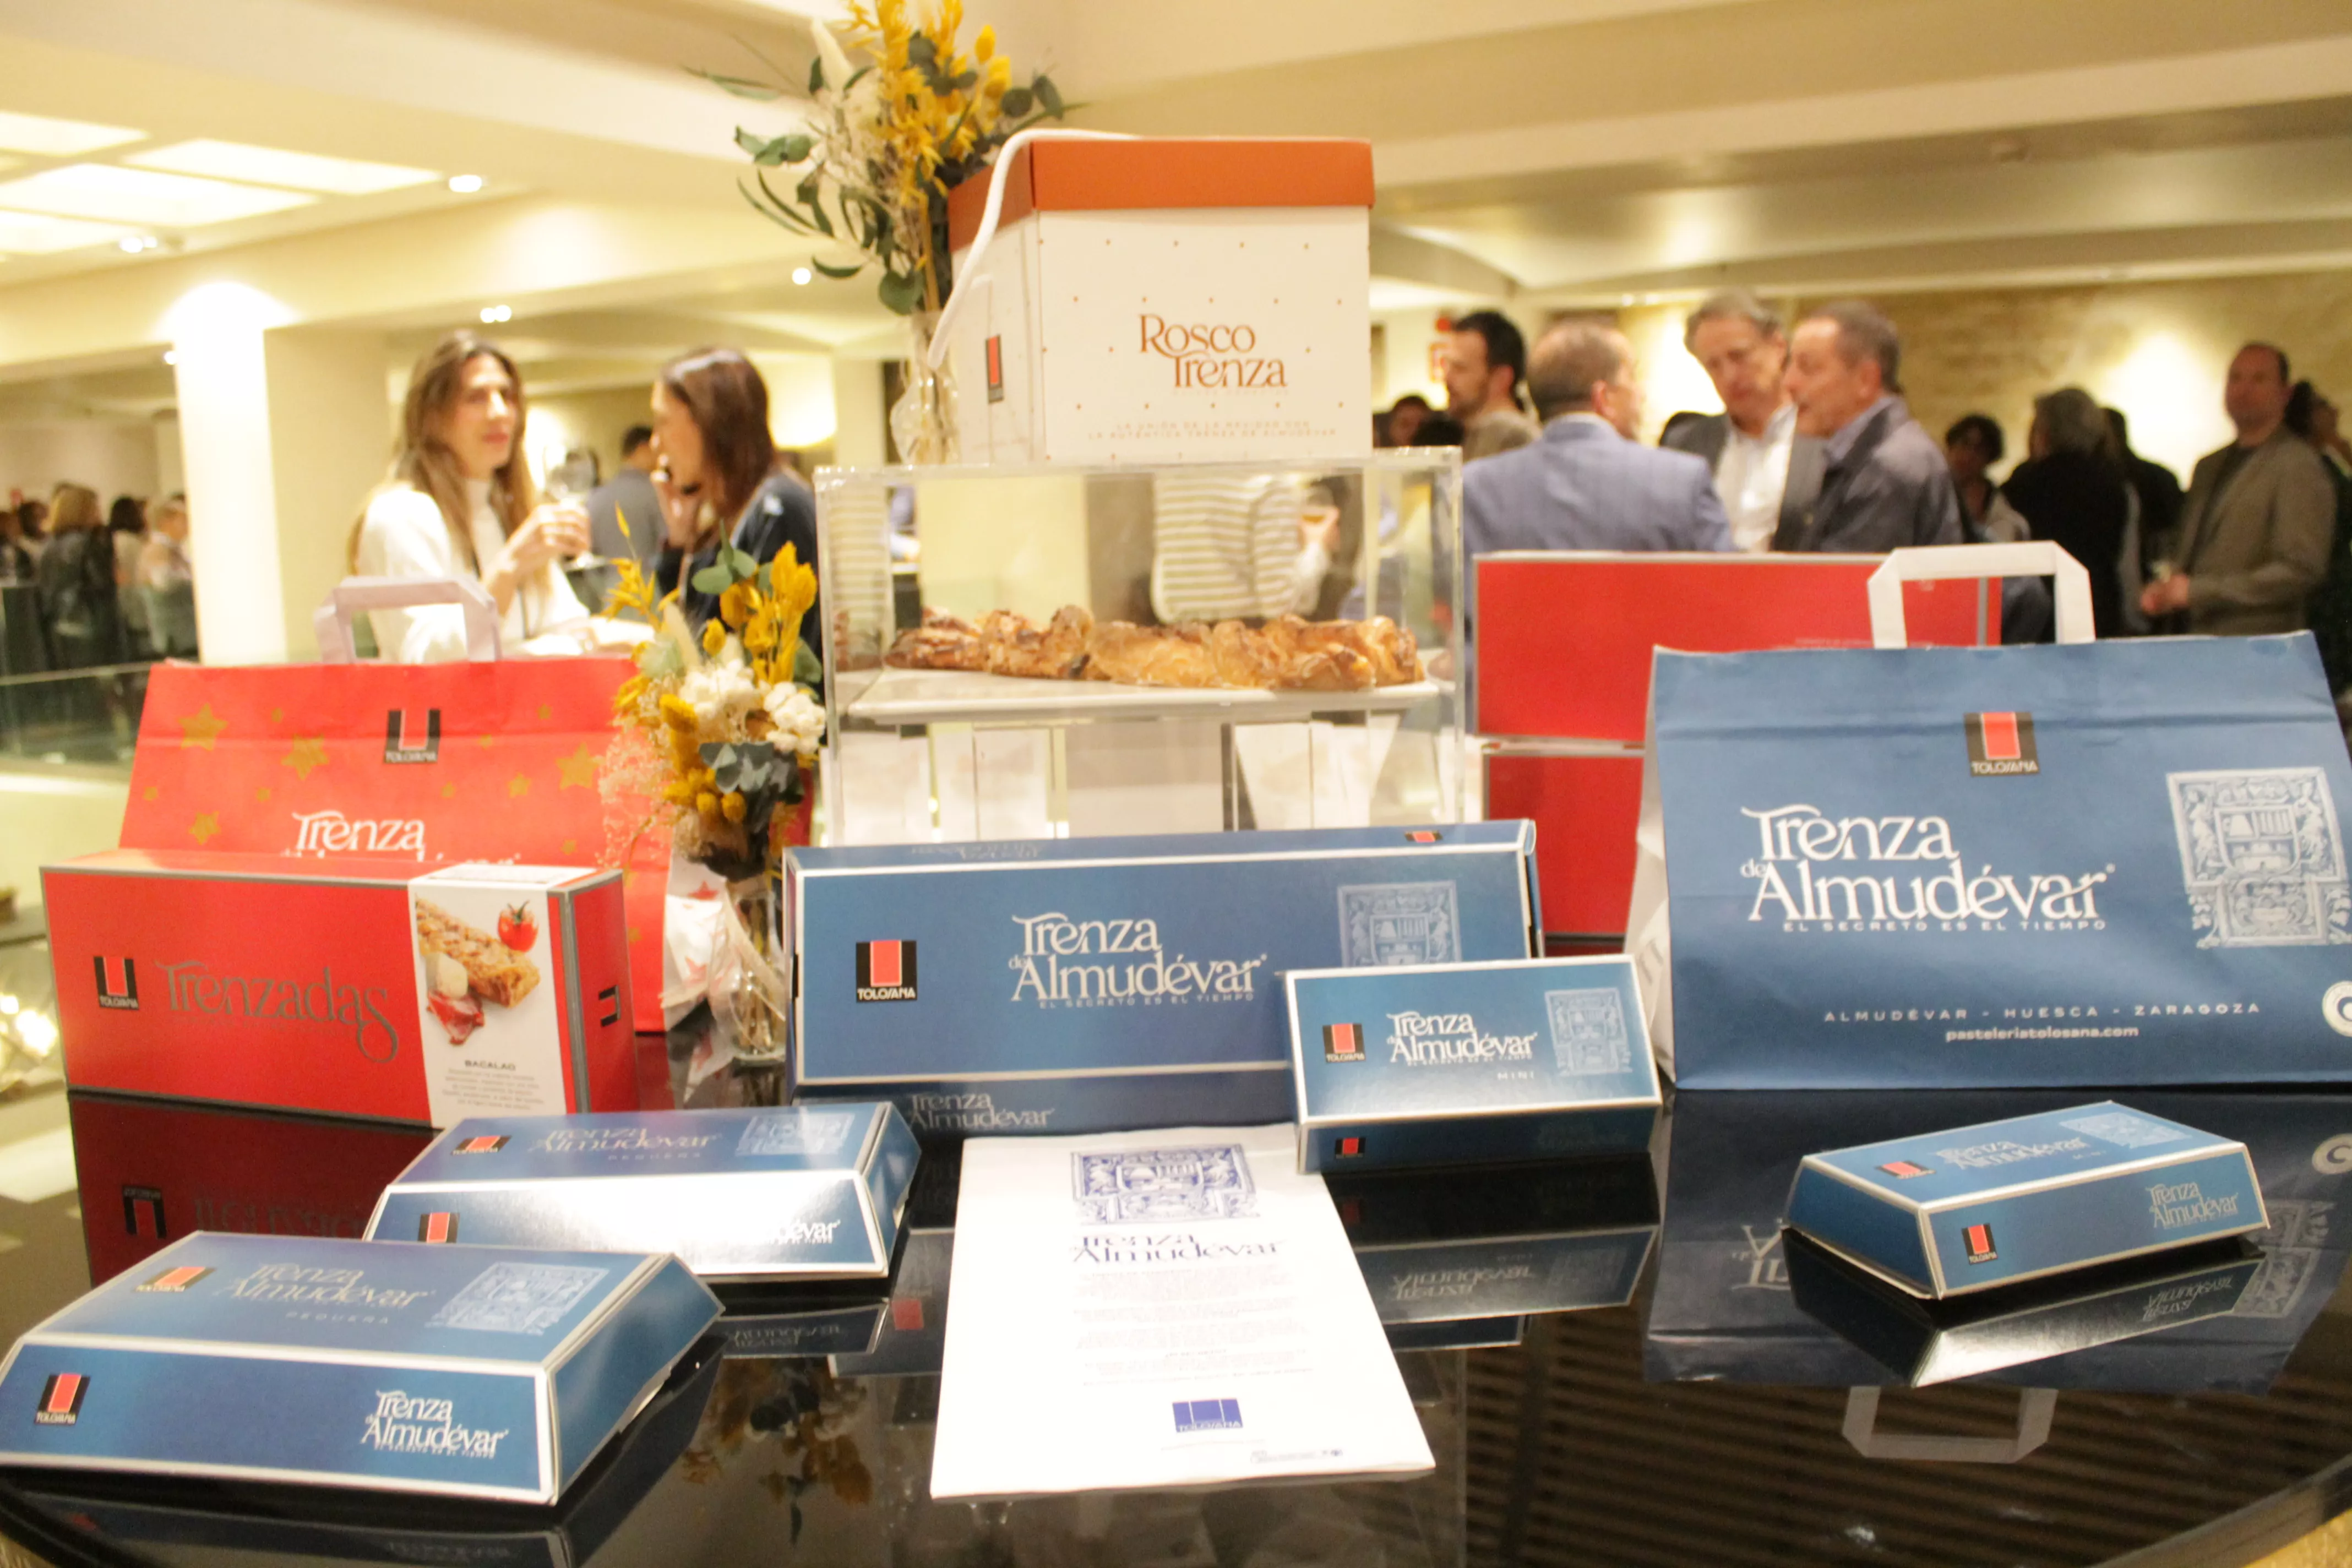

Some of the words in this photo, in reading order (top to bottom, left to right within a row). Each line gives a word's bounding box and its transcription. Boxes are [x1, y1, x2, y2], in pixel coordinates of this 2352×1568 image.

[1138, 314, 1256, 359] Rosco
[1173, 352, 1288, 389] Trenza
[292, 810, 426, 851] Trenza
[1740, 804, 1959, 861] Trenza
[1740, 860, 1767, 878] de
[1011, 912, 1162, 956] Trenza
[1783, 922, 1809, 932] EL
[1823, 921, 1928, 932] SECRETO
[1941, 921, 1968, 931] ES
[1982, 921, 2007, 931] EL
[2020, 920, 2106, 931] TIEMPO
[1009, 955, 1027, 970] de
[1196, 993, 1254, 1003] TIEMPO
[154, 960, 399, 1064] Trenzadas
[1386, 1011, 1476, 1036] Trenza
[1824, 1008, 1968, 1022] ALMUDÉVAR
[2004, 1005, 2098, 1019] HUESCA
[2134, 1003, 2261, 1017] ZARAGOZA
[464, 1060, 516, 1071] BACALAO
[2145, 1181, 2200, 1207] Trenza
[375, 1389, 453, 1422] Trenza
